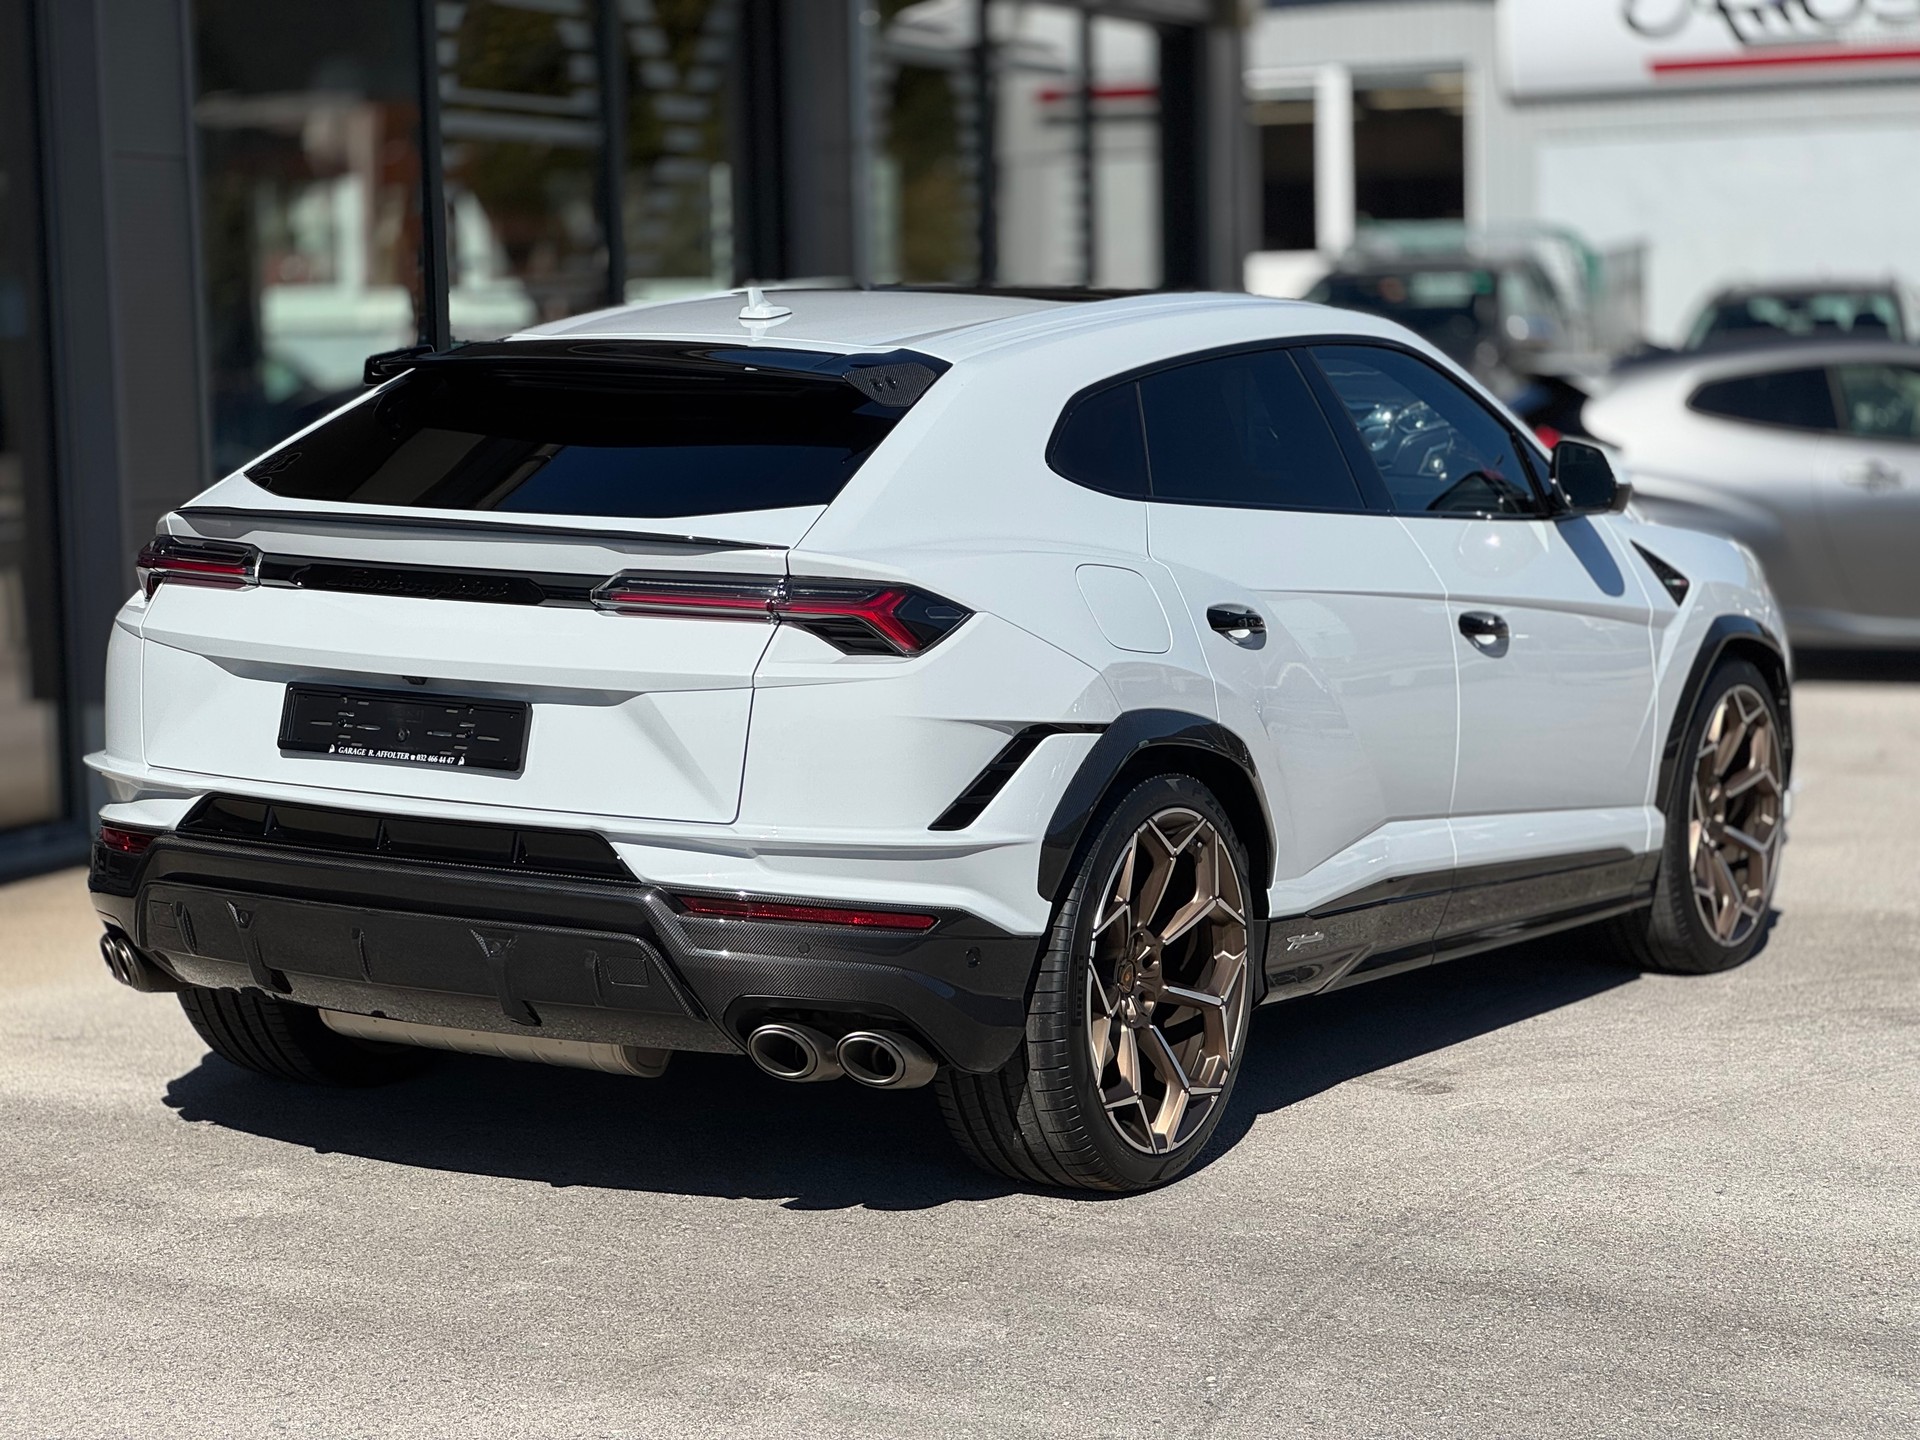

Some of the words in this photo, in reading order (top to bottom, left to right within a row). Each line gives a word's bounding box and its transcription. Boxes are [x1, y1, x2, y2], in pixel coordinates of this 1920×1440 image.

[338, 746, 367, 756] GARAGE
[367, 749, 375, 757] R.
[375, 750, 410, 761] AFFOLTER
[416, 753, 427, 762] 032
